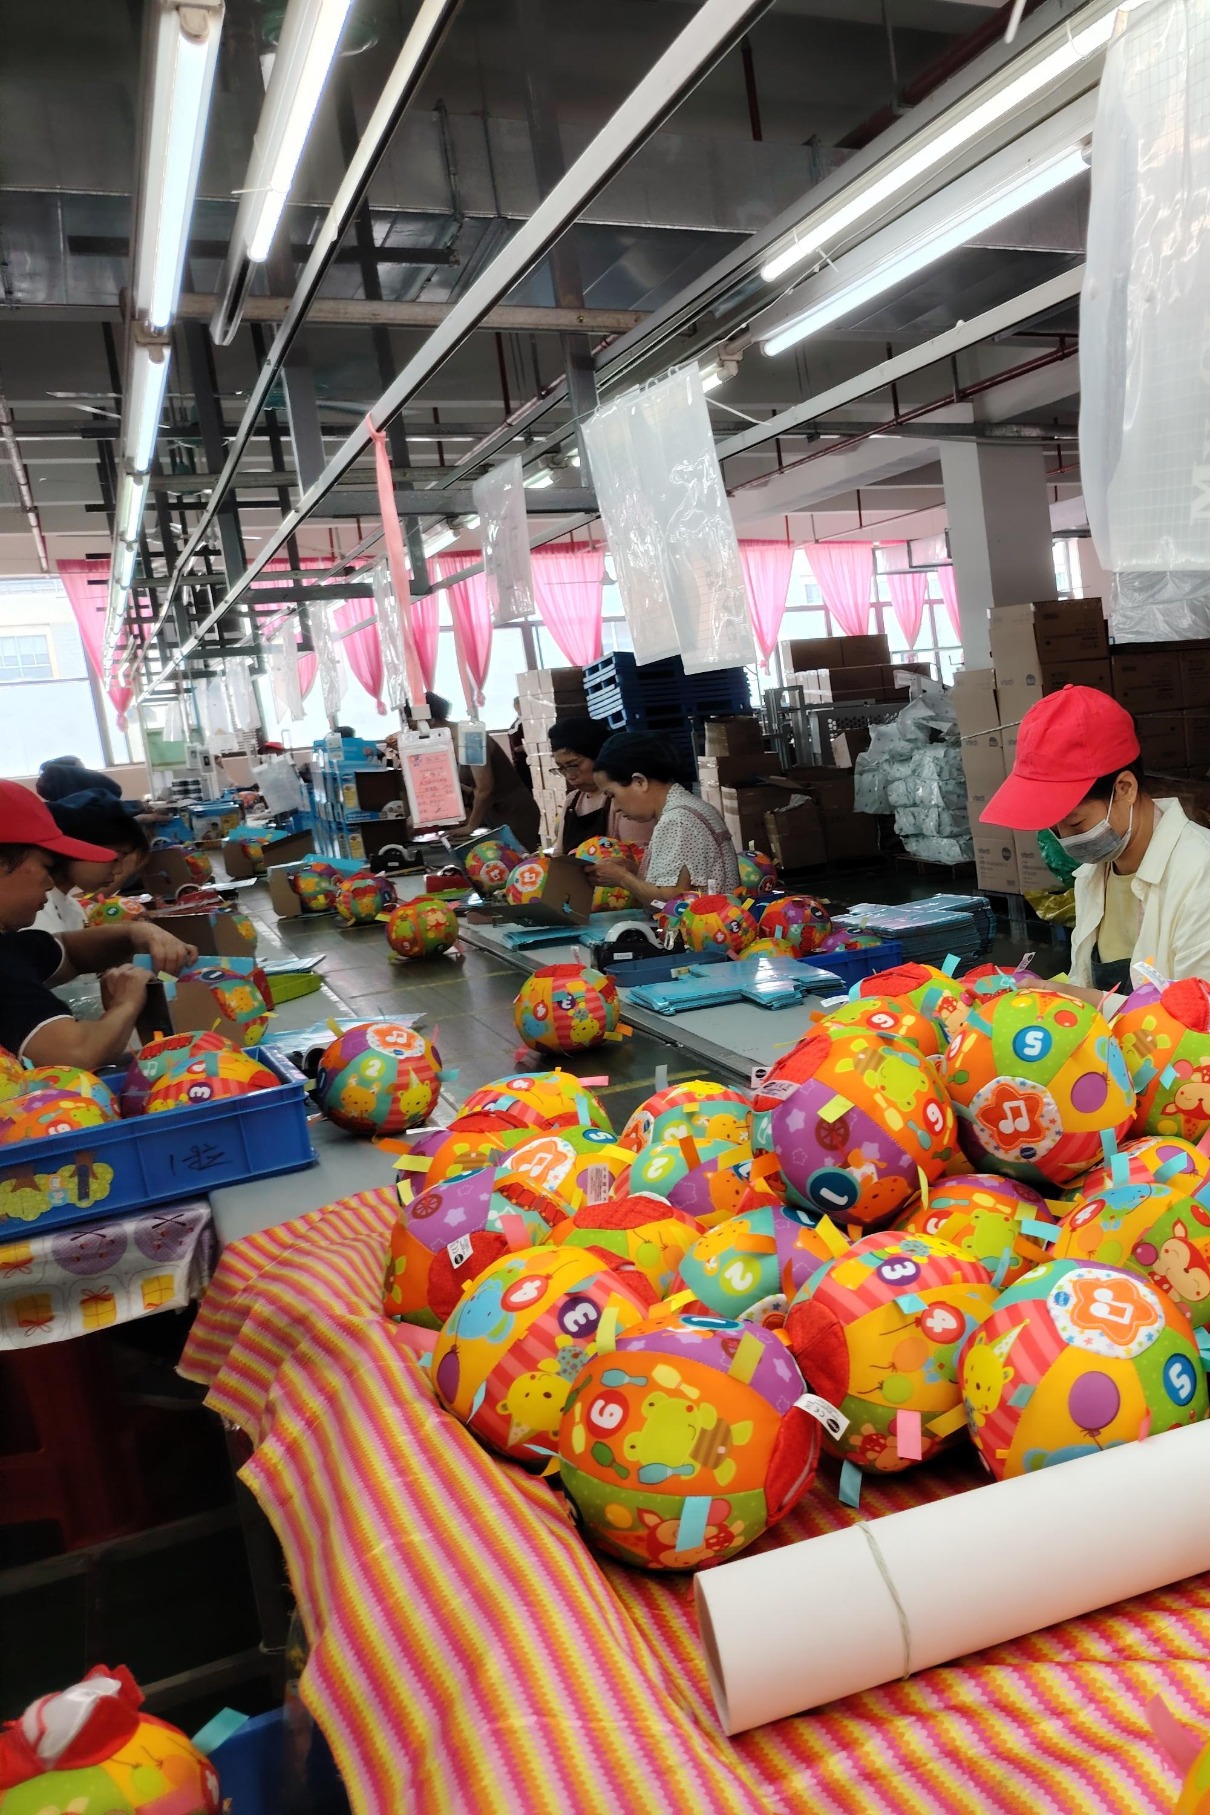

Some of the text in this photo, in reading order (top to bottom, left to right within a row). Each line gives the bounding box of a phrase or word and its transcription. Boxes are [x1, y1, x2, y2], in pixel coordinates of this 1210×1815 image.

[365, 1060, 381, 1077] 2
[510, 1279, 541, 1302] 4
[564, 1303, 597, 1332] 3
[926, 1308, 957, 1332] 4
[1169, 1362, 1191, 1399] 5
